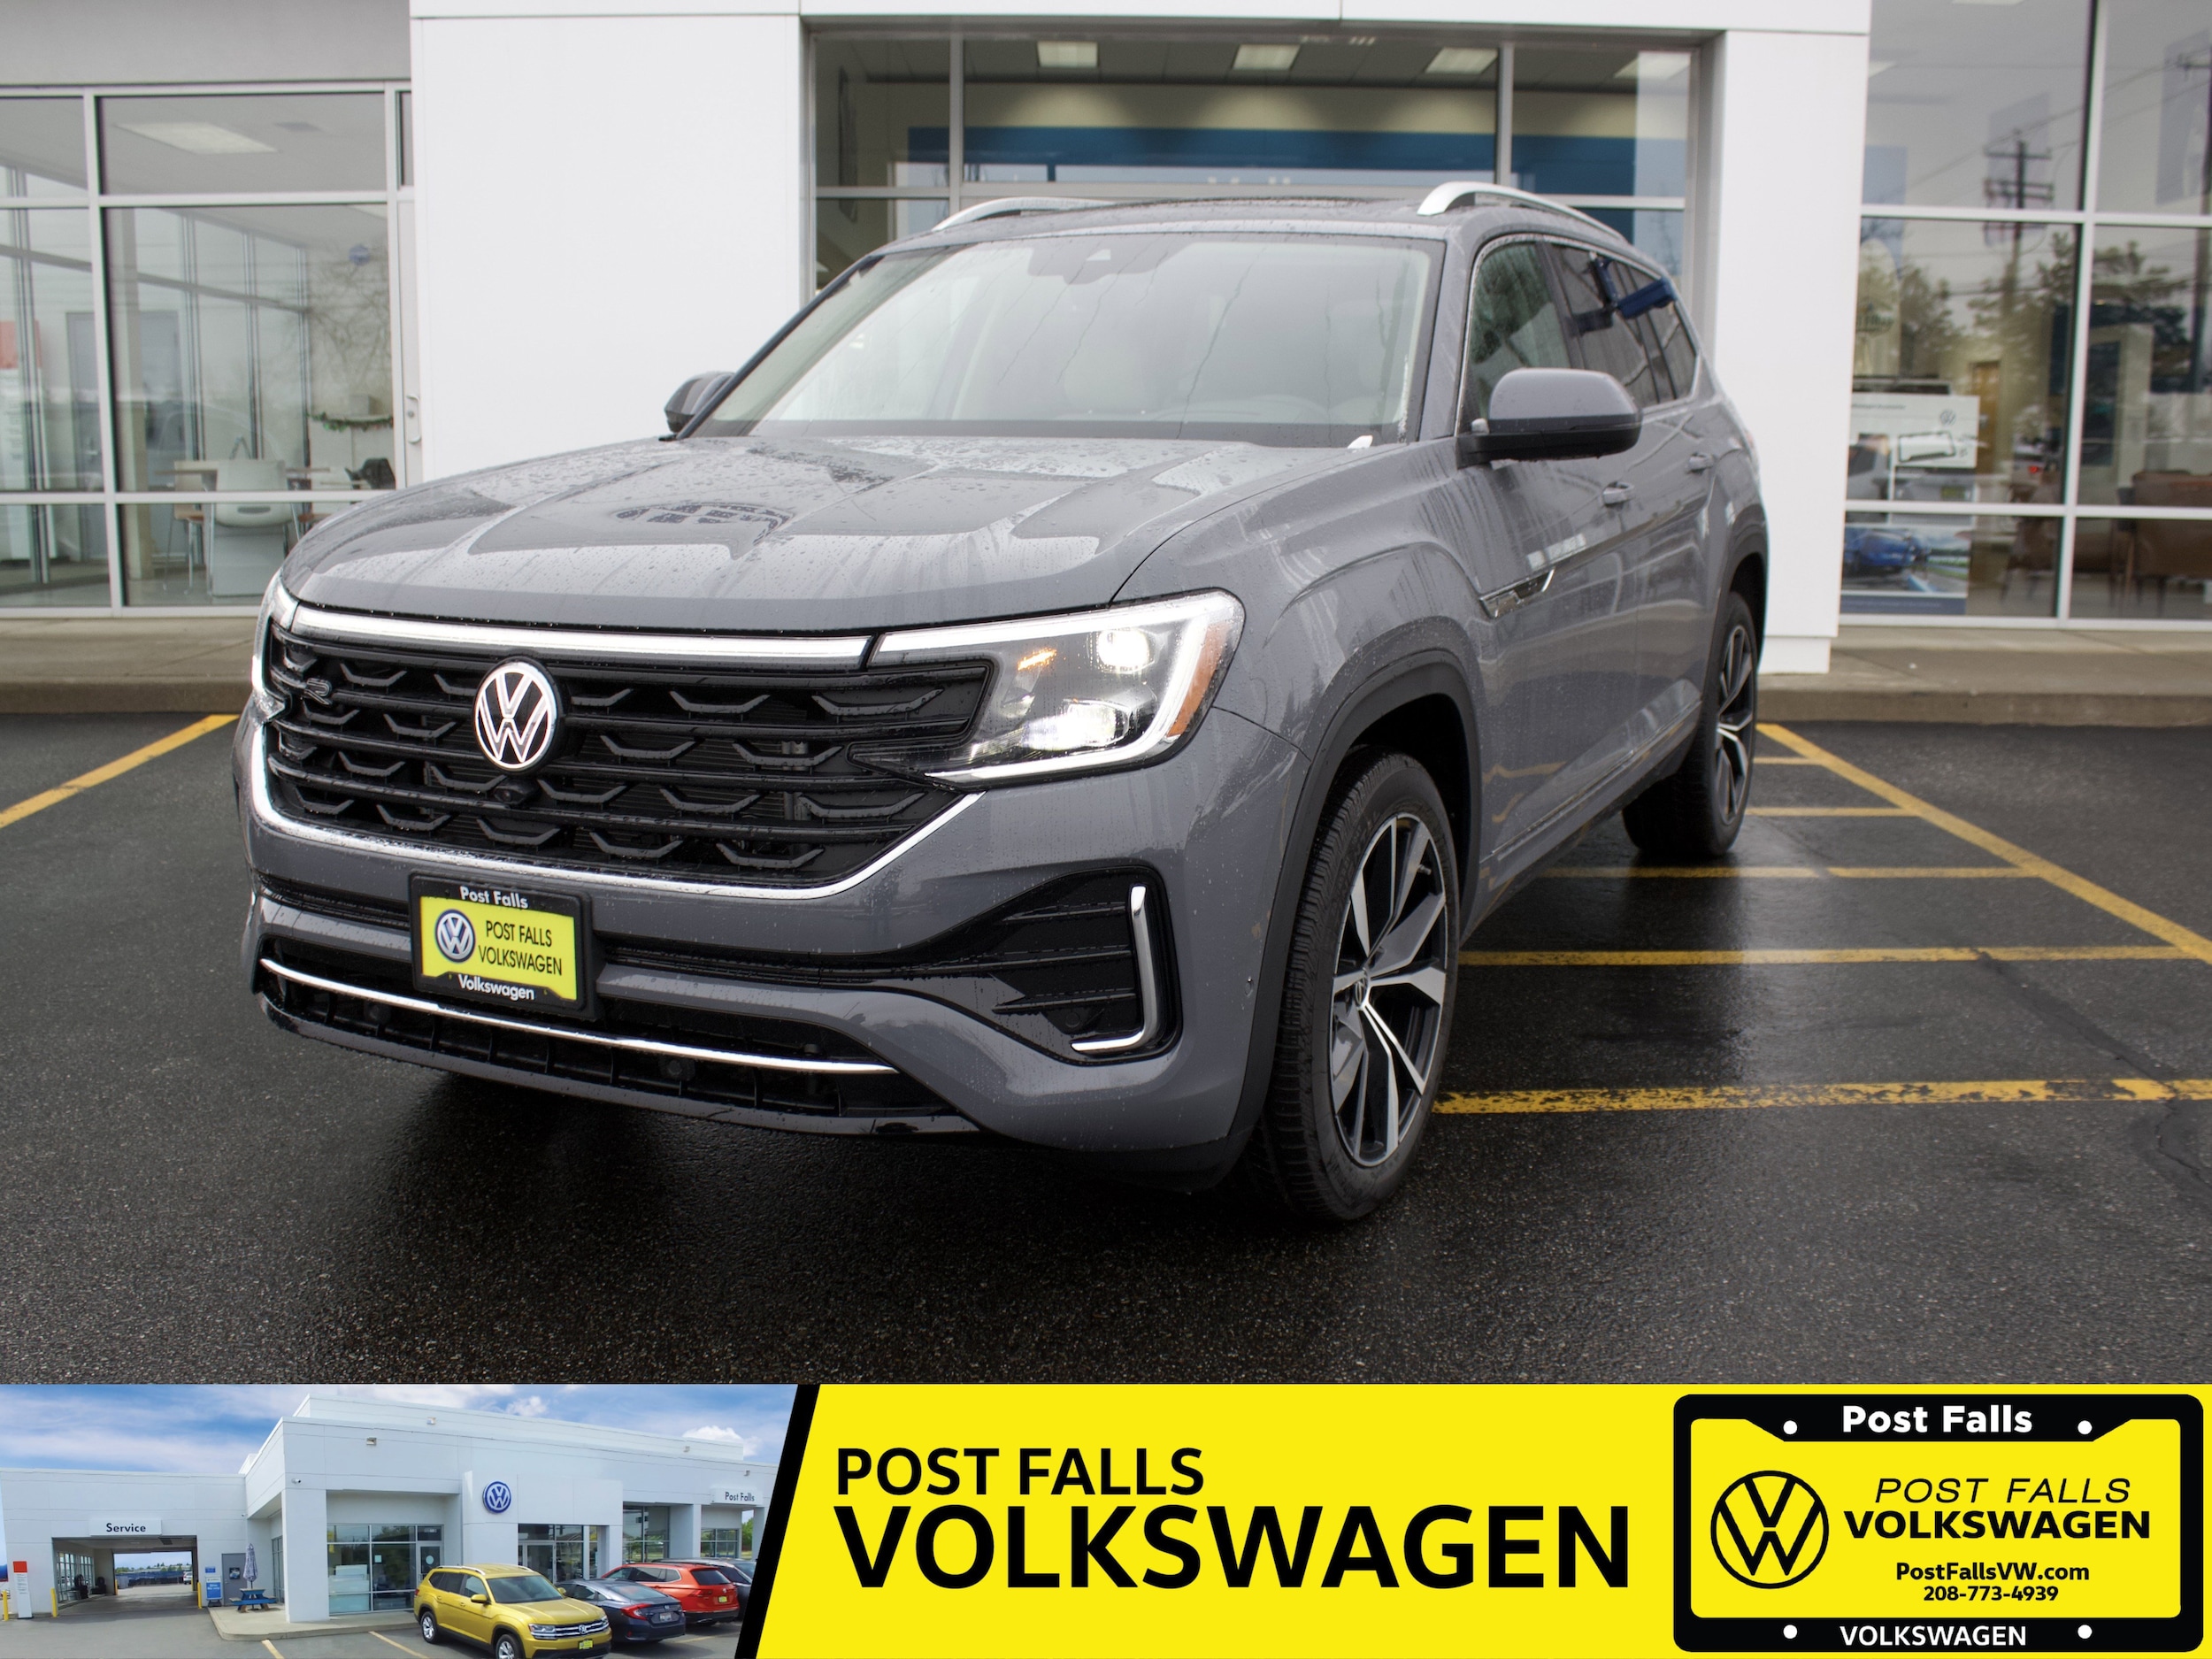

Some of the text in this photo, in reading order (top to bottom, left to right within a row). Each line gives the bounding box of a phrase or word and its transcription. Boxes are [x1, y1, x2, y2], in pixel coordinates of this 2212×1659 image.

[476, 663, 556, 770] VW
[459, 886, 529, 910] Post Falls
[437, 910, 474, 962] VW
[486, 919, 552, 948] POST FALLS
[478, 944, 563, 975] VOLKSWAGEN
[458, 974, 535, 1002] Volkswagen
